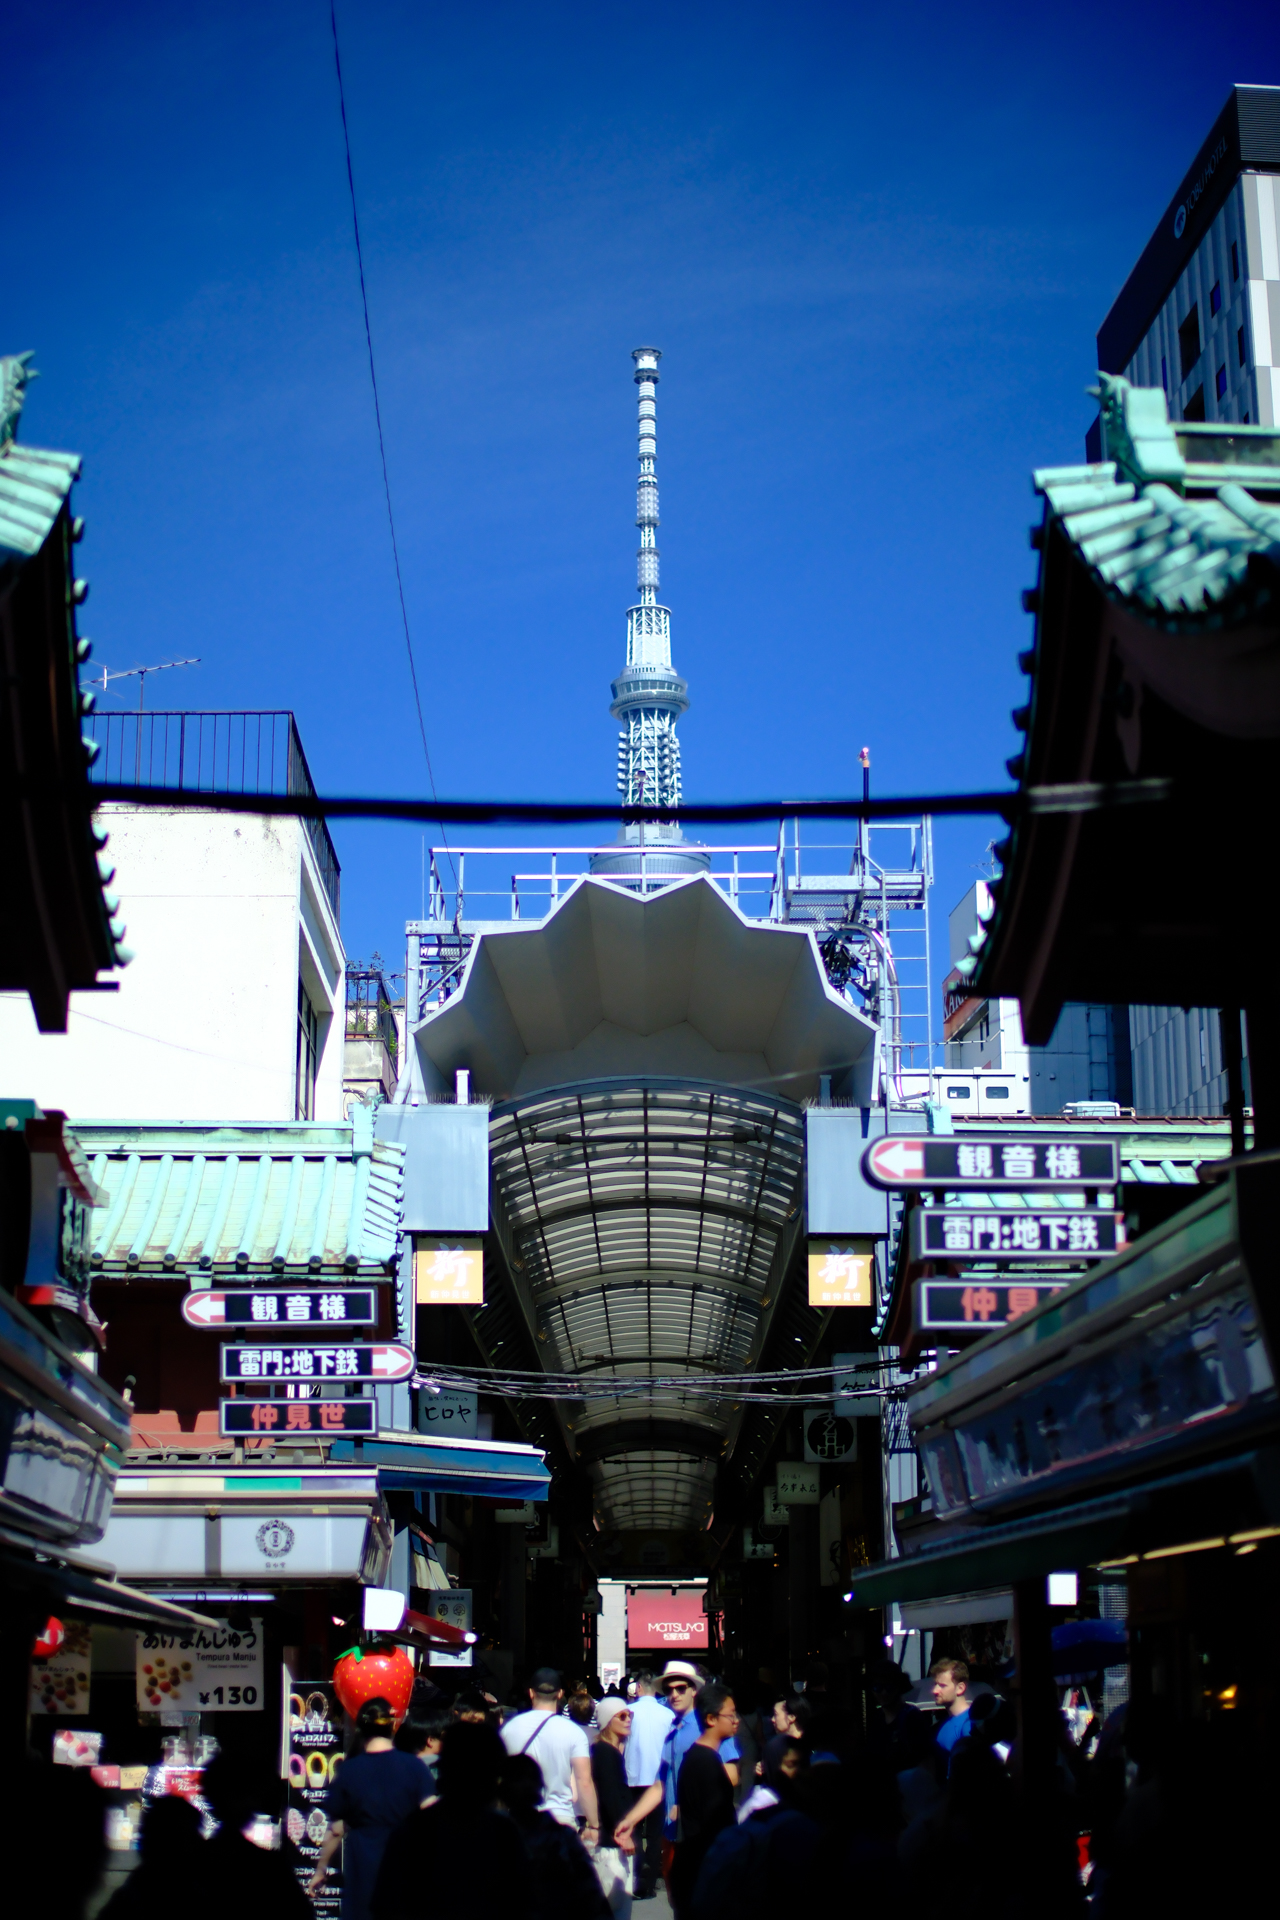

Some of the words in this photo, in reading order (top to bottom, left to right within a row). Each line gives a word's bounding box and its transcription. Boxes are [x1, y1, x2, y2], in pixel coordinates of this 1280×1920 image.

[1186, 173, 1205, 215] TOBU
[1205, 135, 1228, 184] HOTEL
[957, 1144, 1080, 1178] 観音様
[251, 1295, 345, 1320] 観音様
[961, 1287, 1060, 1321] 仲見
[251, 1403, 345, 1429] 仲見世
[425, 1404, 471, 1424] ヒロヤ
[196, 1652, 230, 1661] Tempura
[233, 1652, 257, 1661] Manju
[199, 1686, 257, 1705] ¥130
